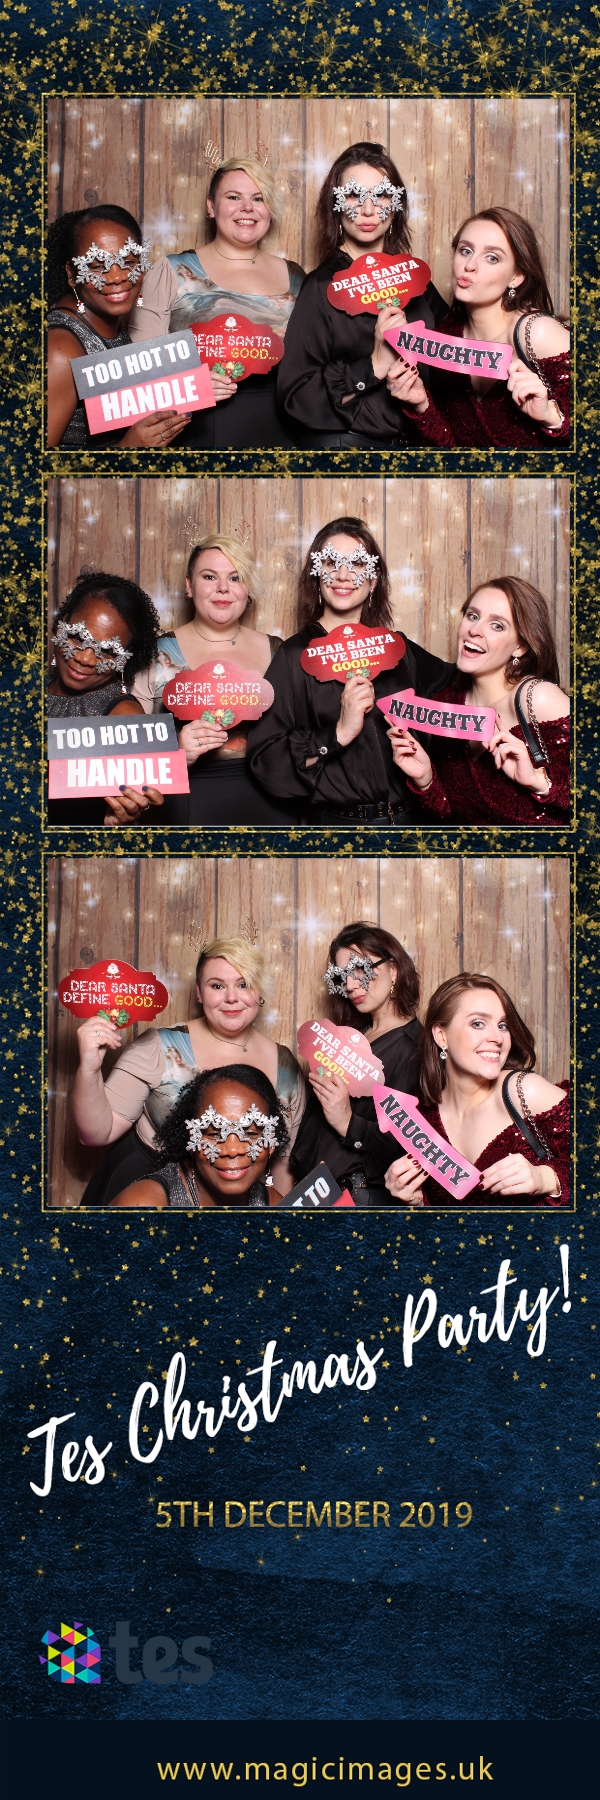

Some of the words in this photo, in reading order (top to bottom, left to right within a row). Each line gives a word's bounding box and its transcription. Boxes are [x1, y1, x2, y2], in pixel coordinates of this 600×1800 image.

[332, 273, 371, 292] DEAR
[371, 260, 420, 280] SANTA
[348, 282, 376, 298] I'VE
[376, 272, 412, 290] BEEN
[361, 286, 409, 304] GOOD...
[227, 335, 272, 348] SANTA
[230, 347, 279, 360] GOOD...
[396, 330, 504, 371] NAUGHTY
[82, 359, 123, 387] TOO
[125, 346, 162, 376] HOT
[164, 340, 191, 363] TO
[100, 375, 199, 422] HANDLE
[306, 643, 345, 658] DEAR
[346, 633, 396, 651] SANTA
[321, 651, 349, 665] I'VE
[350, 645, 386, 660] BEEN
[331, 658, 380, 673] GOOD...
[167, 694, 216, 706] DEFINE
[219, 694, 269, 706] GOOD...
[175, 682, 212, 694] DEAR
[216, 682, 261, 694] SANTA
[388, 698, 487, 733] NAUGHTY
[53, 727, 96, 750] TOO
[100, 724, 140, 746] HOT
[142, 722, 169, 742] TO
[67, 757, 173, 788] HANDLE
[63, 991, 111, 1006] DEFINE
[114, 994, 163, 1008] GOOD...
[70, 979, 107, 993] DEAR
[110, 982, 156, 996] SANTA
[310, 1021, 341, 1050] DEAR
[340, 1045, 380, 1082] SANTA
[312, 1036, 337, 1059] I'VE
[334, 1054, 366, 1082] BEEN
[378, 1092, 472, 1188] NAUGHTY
[304, 1177, 331, 1206] TO
